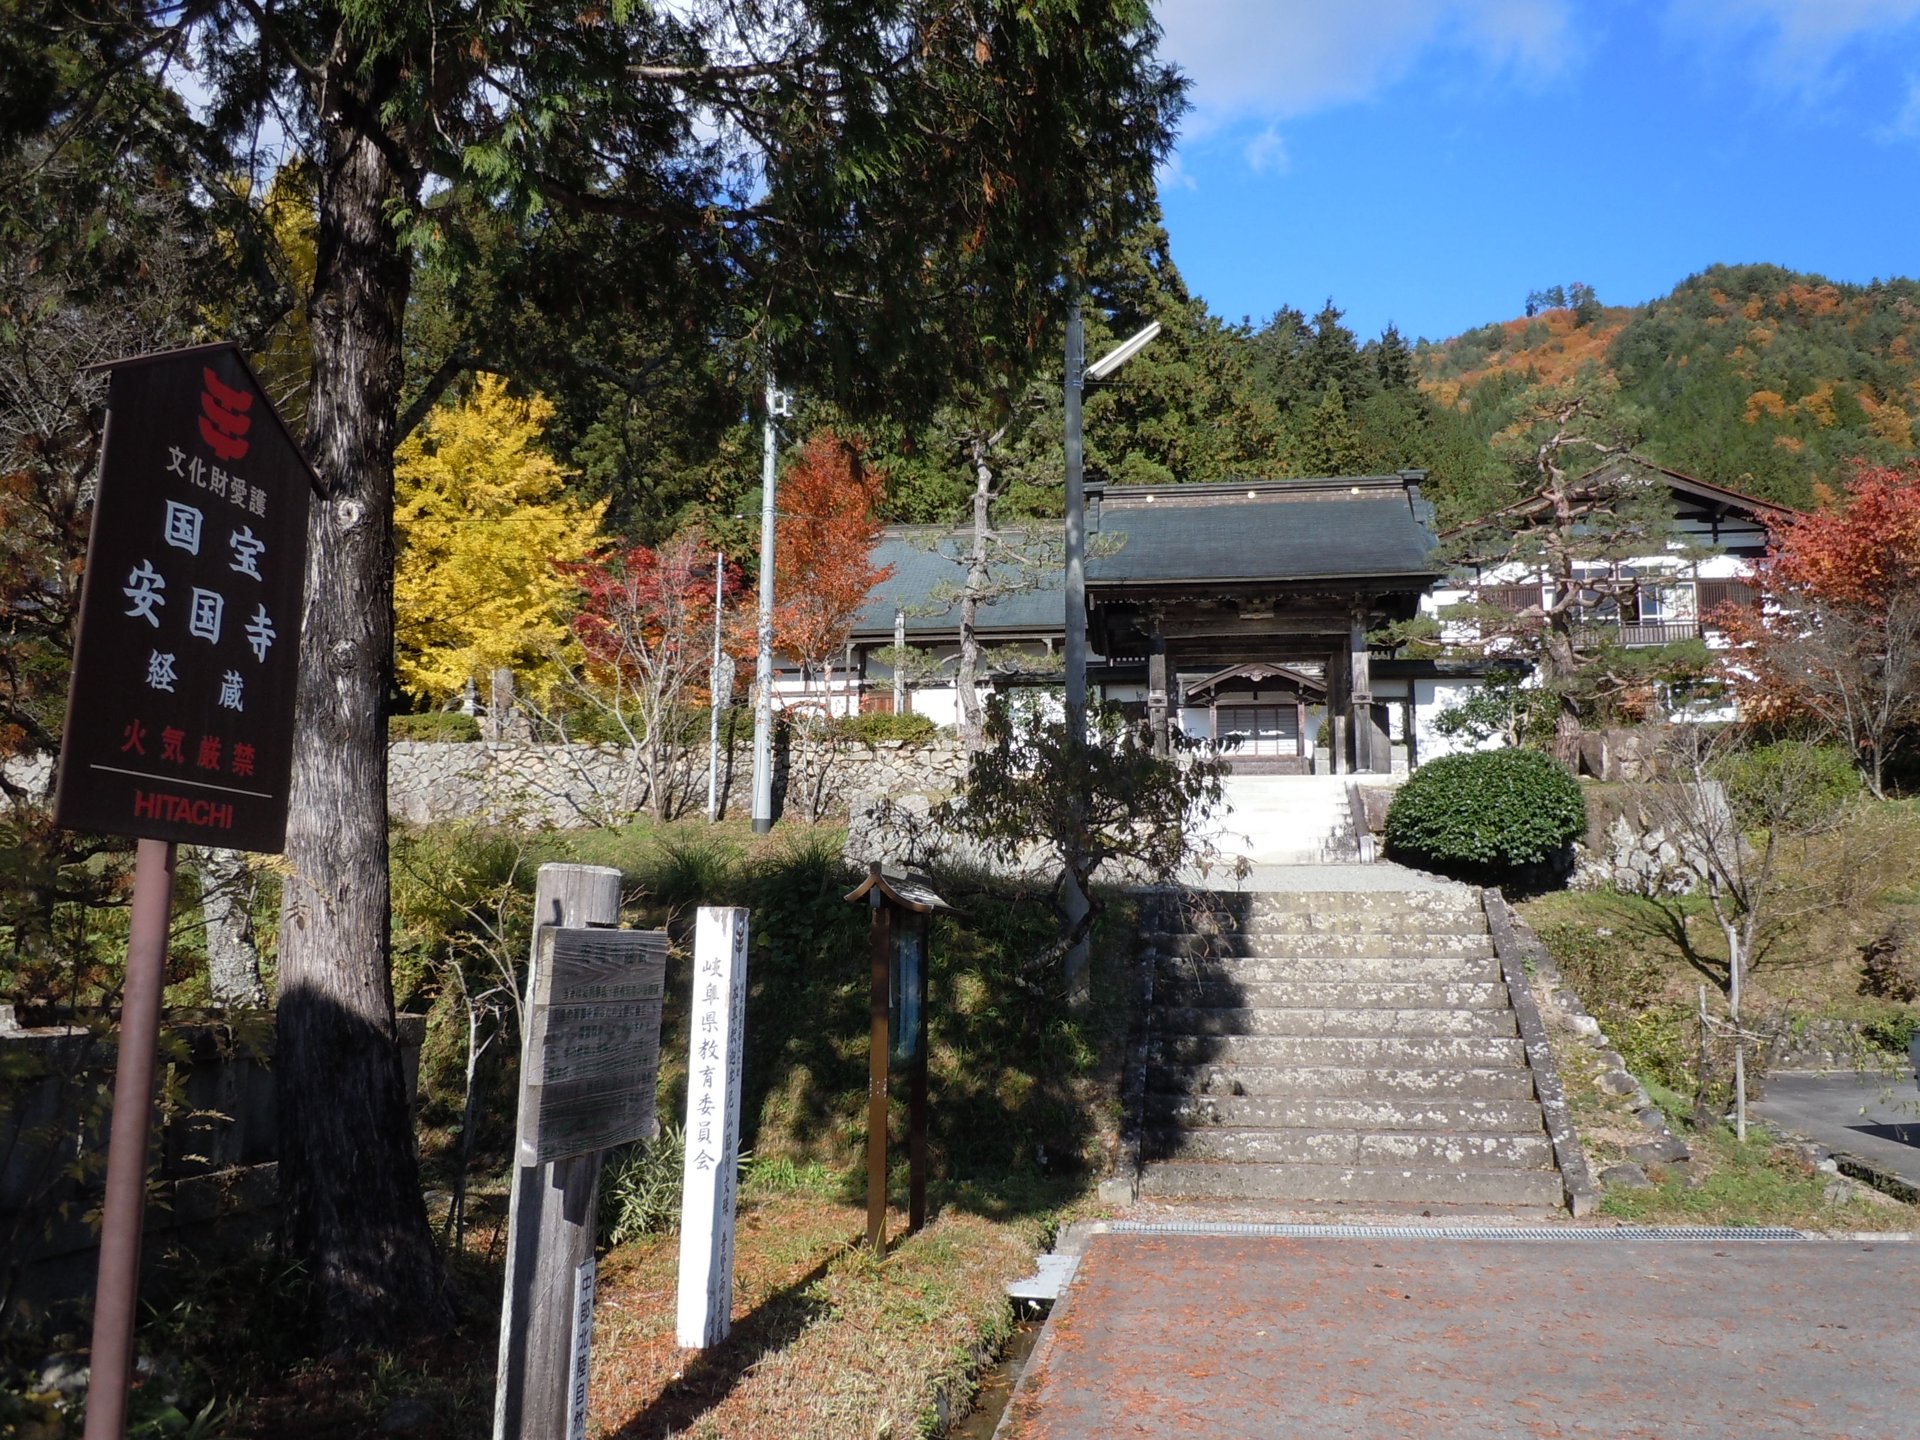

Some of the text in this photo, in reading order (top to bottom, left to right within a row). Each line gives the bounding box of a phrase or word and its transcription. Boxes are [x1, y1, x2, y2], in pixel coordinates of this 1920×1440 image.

[166, 446, 267, 518] 文化財愛護
[164, 499, 266, 582] 国宝
[123, 558, 277, 664] 安国寺
[145, 648, 245, 712] 経蔵
[121, 719, 256, 776] 火気厳禁
[134, 790, 233, 829] HITACHI
[693, 957, 723, 1172] 岐阜県教育委員会
[572, 1273, 592, 1440] 中部北陸自然
